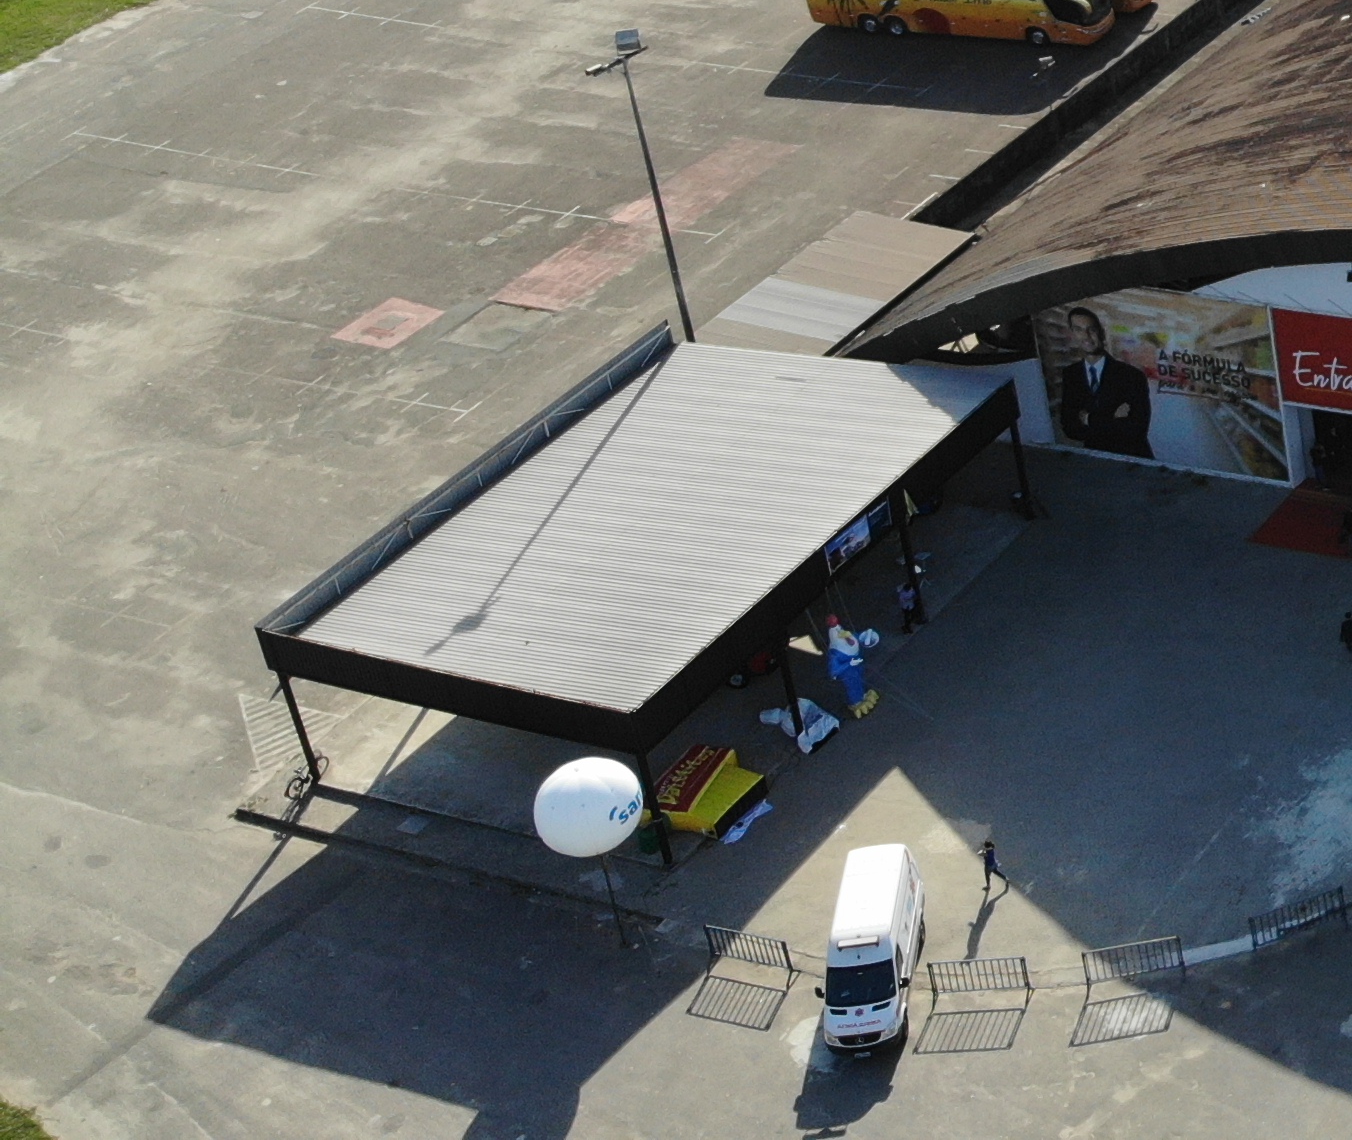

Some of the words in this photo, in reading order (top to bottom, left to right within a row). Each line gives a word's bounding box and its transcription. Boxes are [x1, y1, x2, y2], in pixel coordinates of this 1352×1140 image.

[1159, 349, 1168, 361] A
[1172, 349, 1247, 374] FÓRMULA
[1157, 363, 1178, 377] DE
[1181, 366, 1252, 390] SUCESSO
